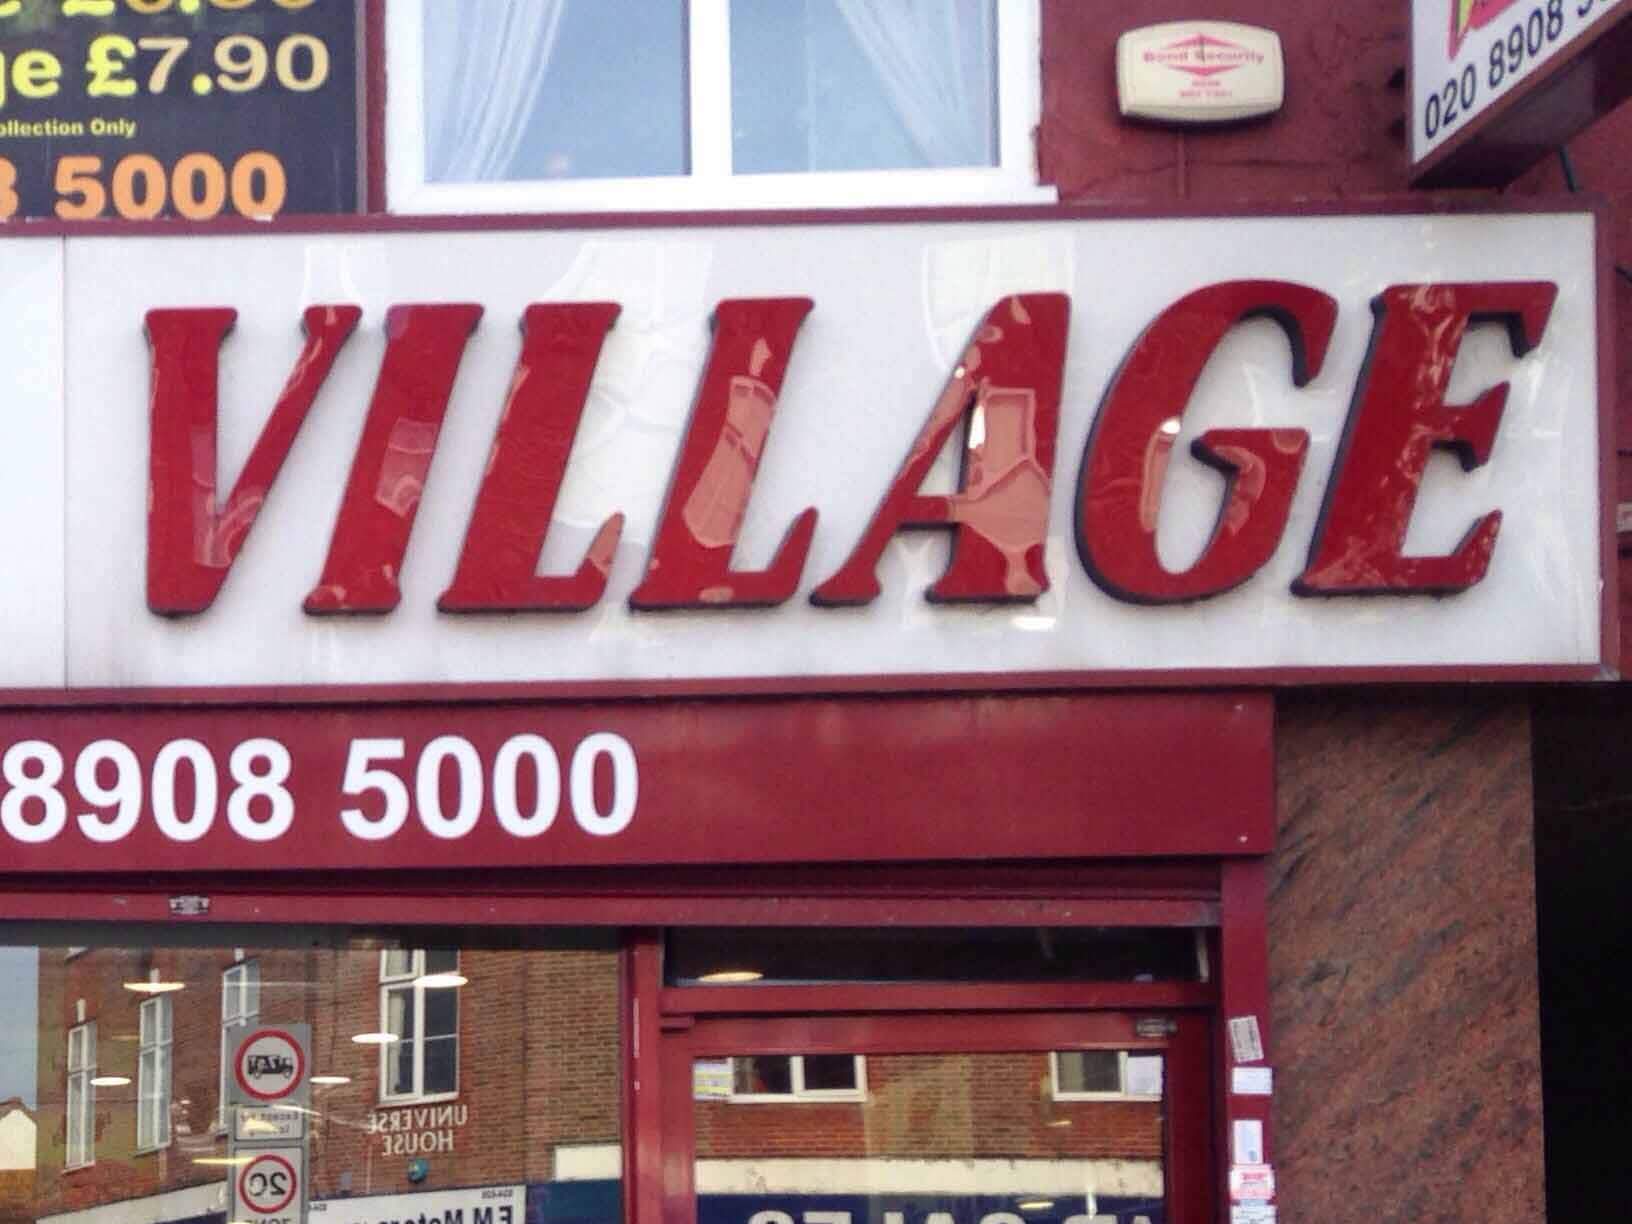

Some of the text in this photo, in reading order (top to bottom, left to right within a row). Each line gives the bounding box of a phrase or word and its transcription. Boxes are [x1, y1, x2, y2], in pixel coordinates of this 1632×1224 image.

[87, 34, 330, 96] £7.90
[1424, 0, 1563, 139] 020 8908
[89, 118, 137, 139] Only
[54, 152, 287, 219] 5000
[143, 280, 1558, 617] VILLAGE
[0, 737, 296, 844] 8908
[339, 731, 640, 840] 5000
